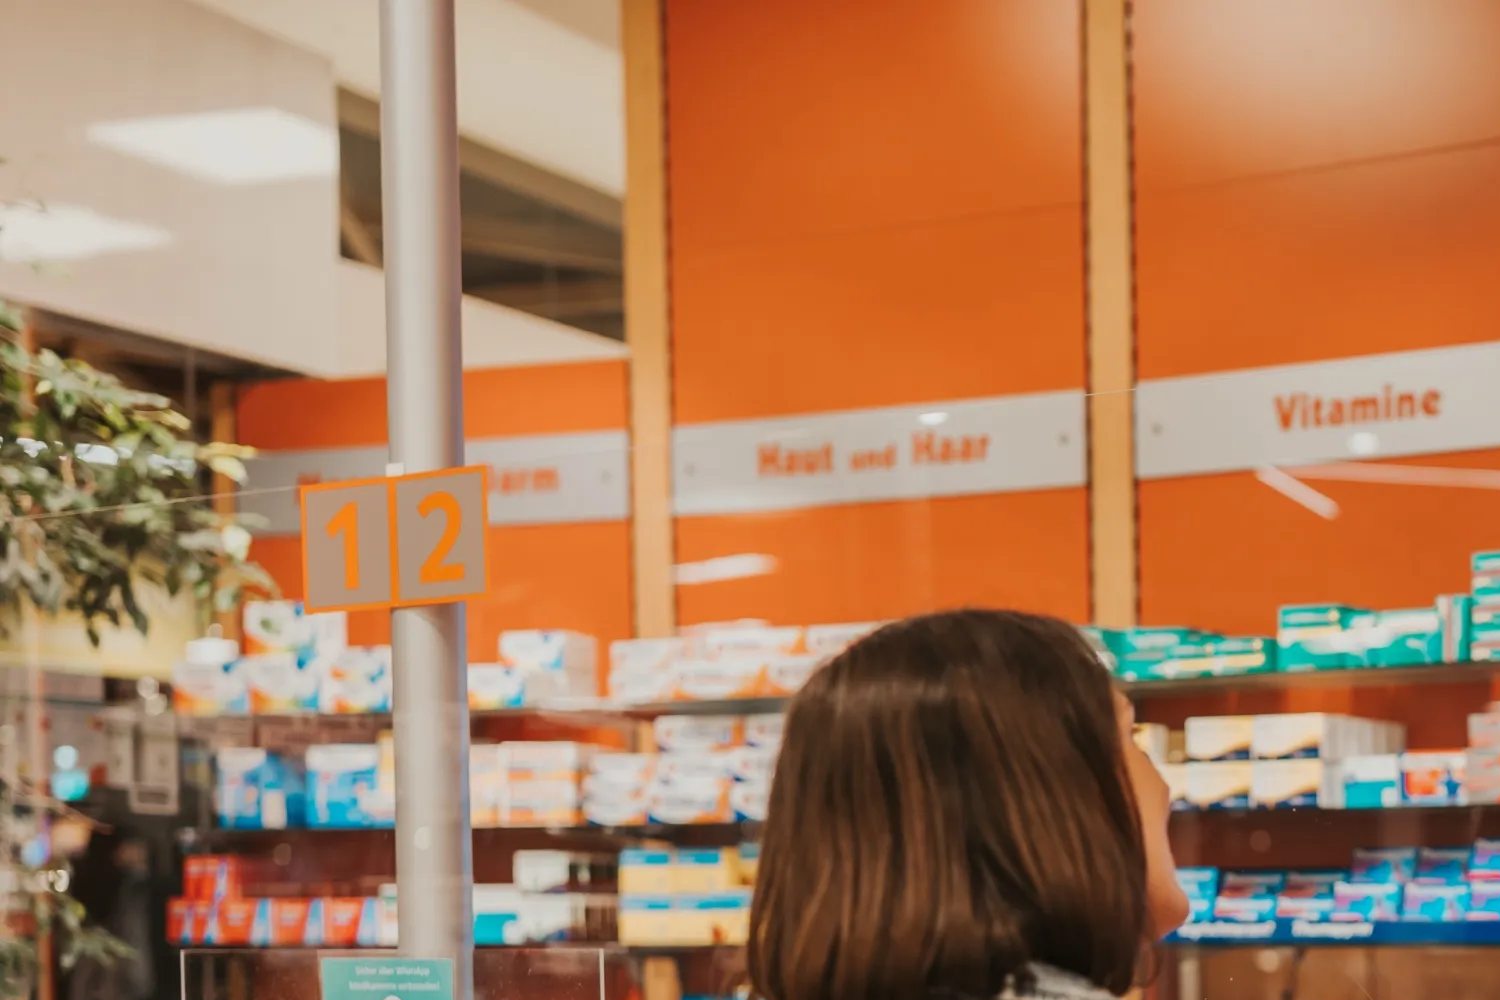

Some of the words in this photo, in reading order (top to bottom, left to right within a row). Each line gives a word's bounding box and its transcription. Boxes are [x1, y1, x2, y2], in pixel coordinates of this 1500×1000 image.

[1275, 384, 1442, 431] Vitamine
[757, 441, 835, 477] Haut
[849, 444, 896, 471] und
[911, 433, 992, 466] Haar
[325, 501, 360, 590] 1
[416, 491, 466, 583] 2
